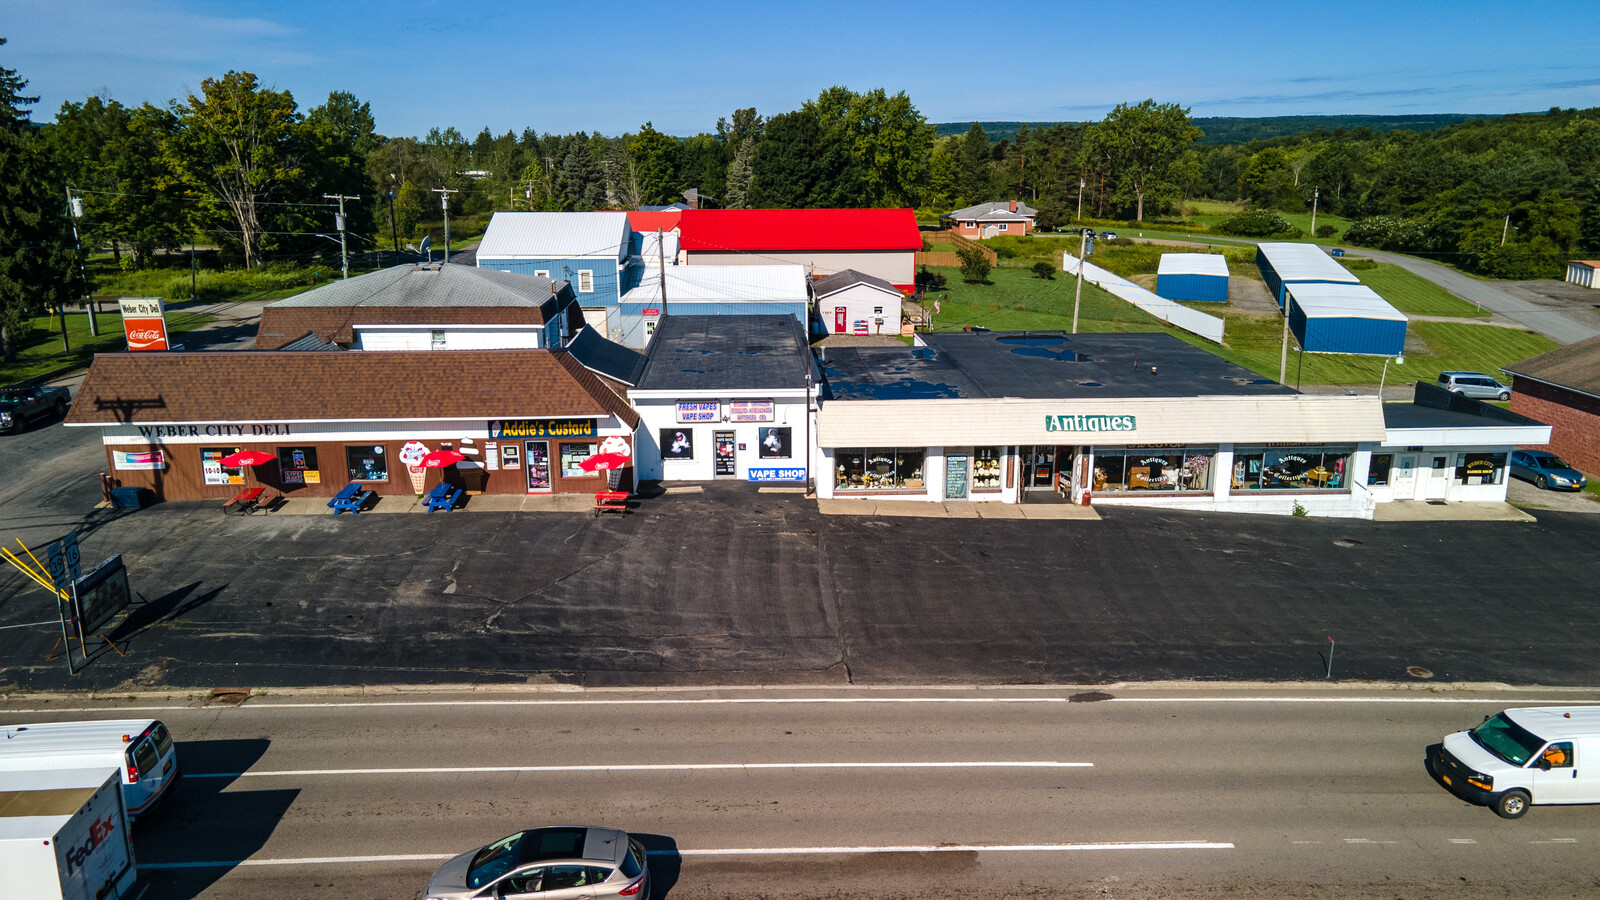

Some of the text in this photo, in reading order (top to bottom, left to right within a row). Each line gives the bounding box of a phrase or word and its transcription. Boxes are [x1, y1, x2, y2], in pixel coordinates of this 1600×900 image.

[122, 304, 159, 315] Weber City Deli
[129, 330, 160, 340] Coca-Cola
[678, 402, 717, 411] FRESH VAPES
[682, 412, 714, 421] VAPE SHOP
[502, 419, 592, 437] Addie's Custard
[1048, 414, 1133, 432] Antiques
[137, 423, 291, 437] WEBER CITY DELI
[1140, 457, 1168, 466] Antiques
[1278, 454, 1307, 464] Antiques
[750, 470, 805, 478] VAPE SHOP
[67, 547, 77, 563] 16
[52, 558, 62, 574] 39
[65, 814, 115, 878] FedEx
